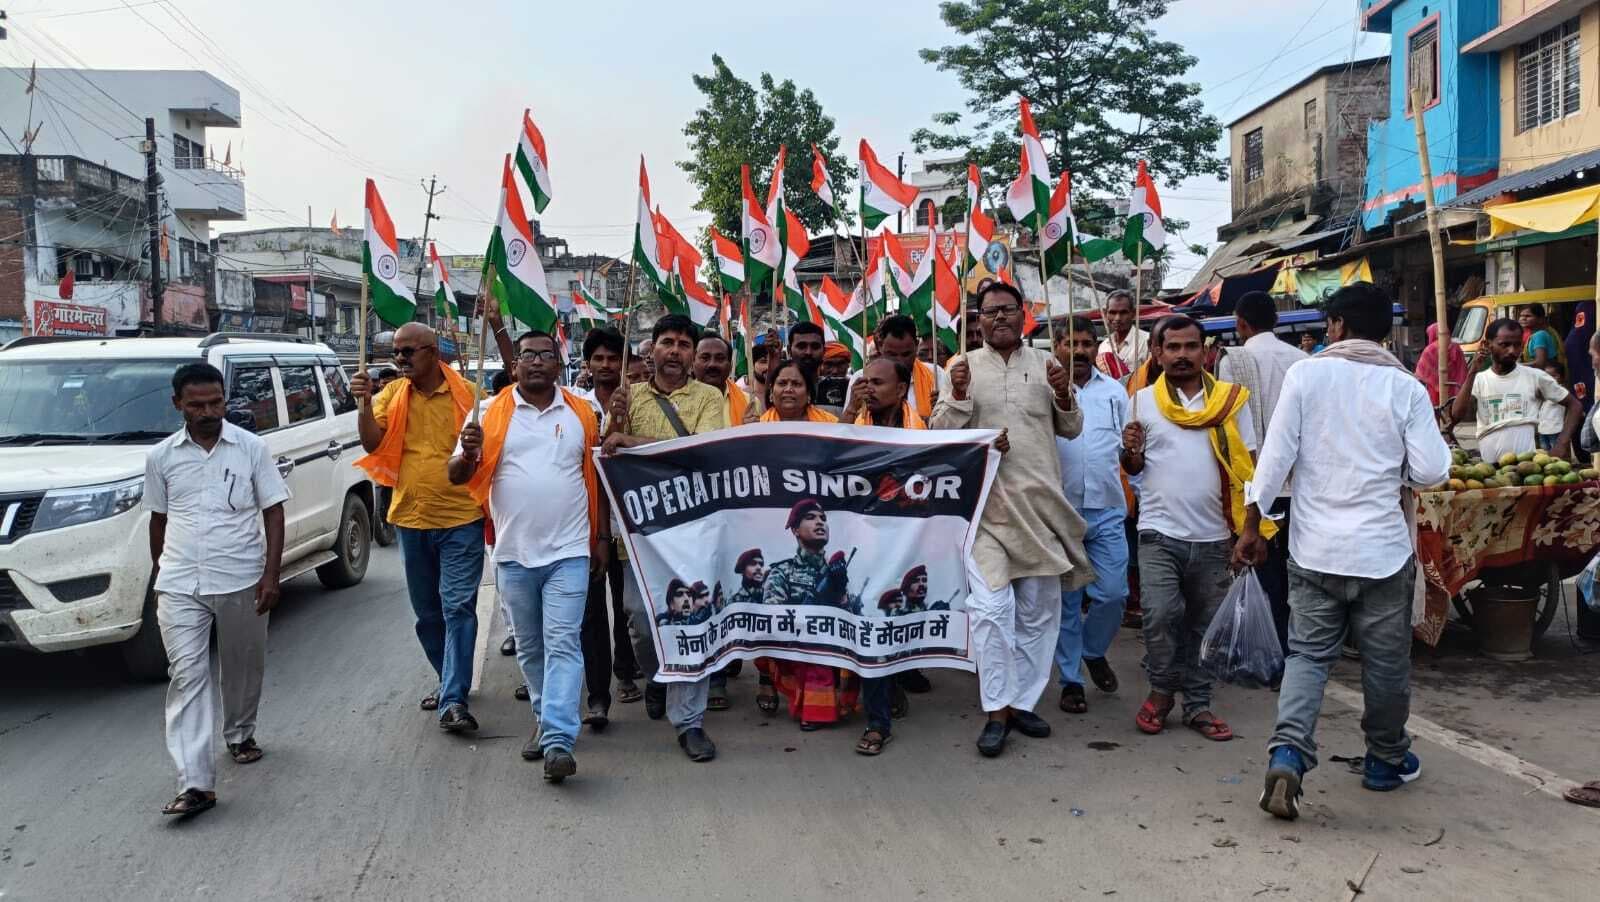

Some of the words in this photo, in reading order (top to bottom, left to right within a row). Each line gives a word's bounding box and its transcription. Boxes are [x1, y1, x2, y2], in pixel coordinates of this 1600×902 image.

[623, 465, 771, 526] OPERATION
[676, 629, 708, 656] सेना
[708, 621, 719, 645] के
[720, 612, 773, 639] सम्मान
[776, 609, 801, 637] में,
[805, 615, 835, 636] हम
[875, 620, 926, 646] मैदान
[929, 614, 950, 639] में
